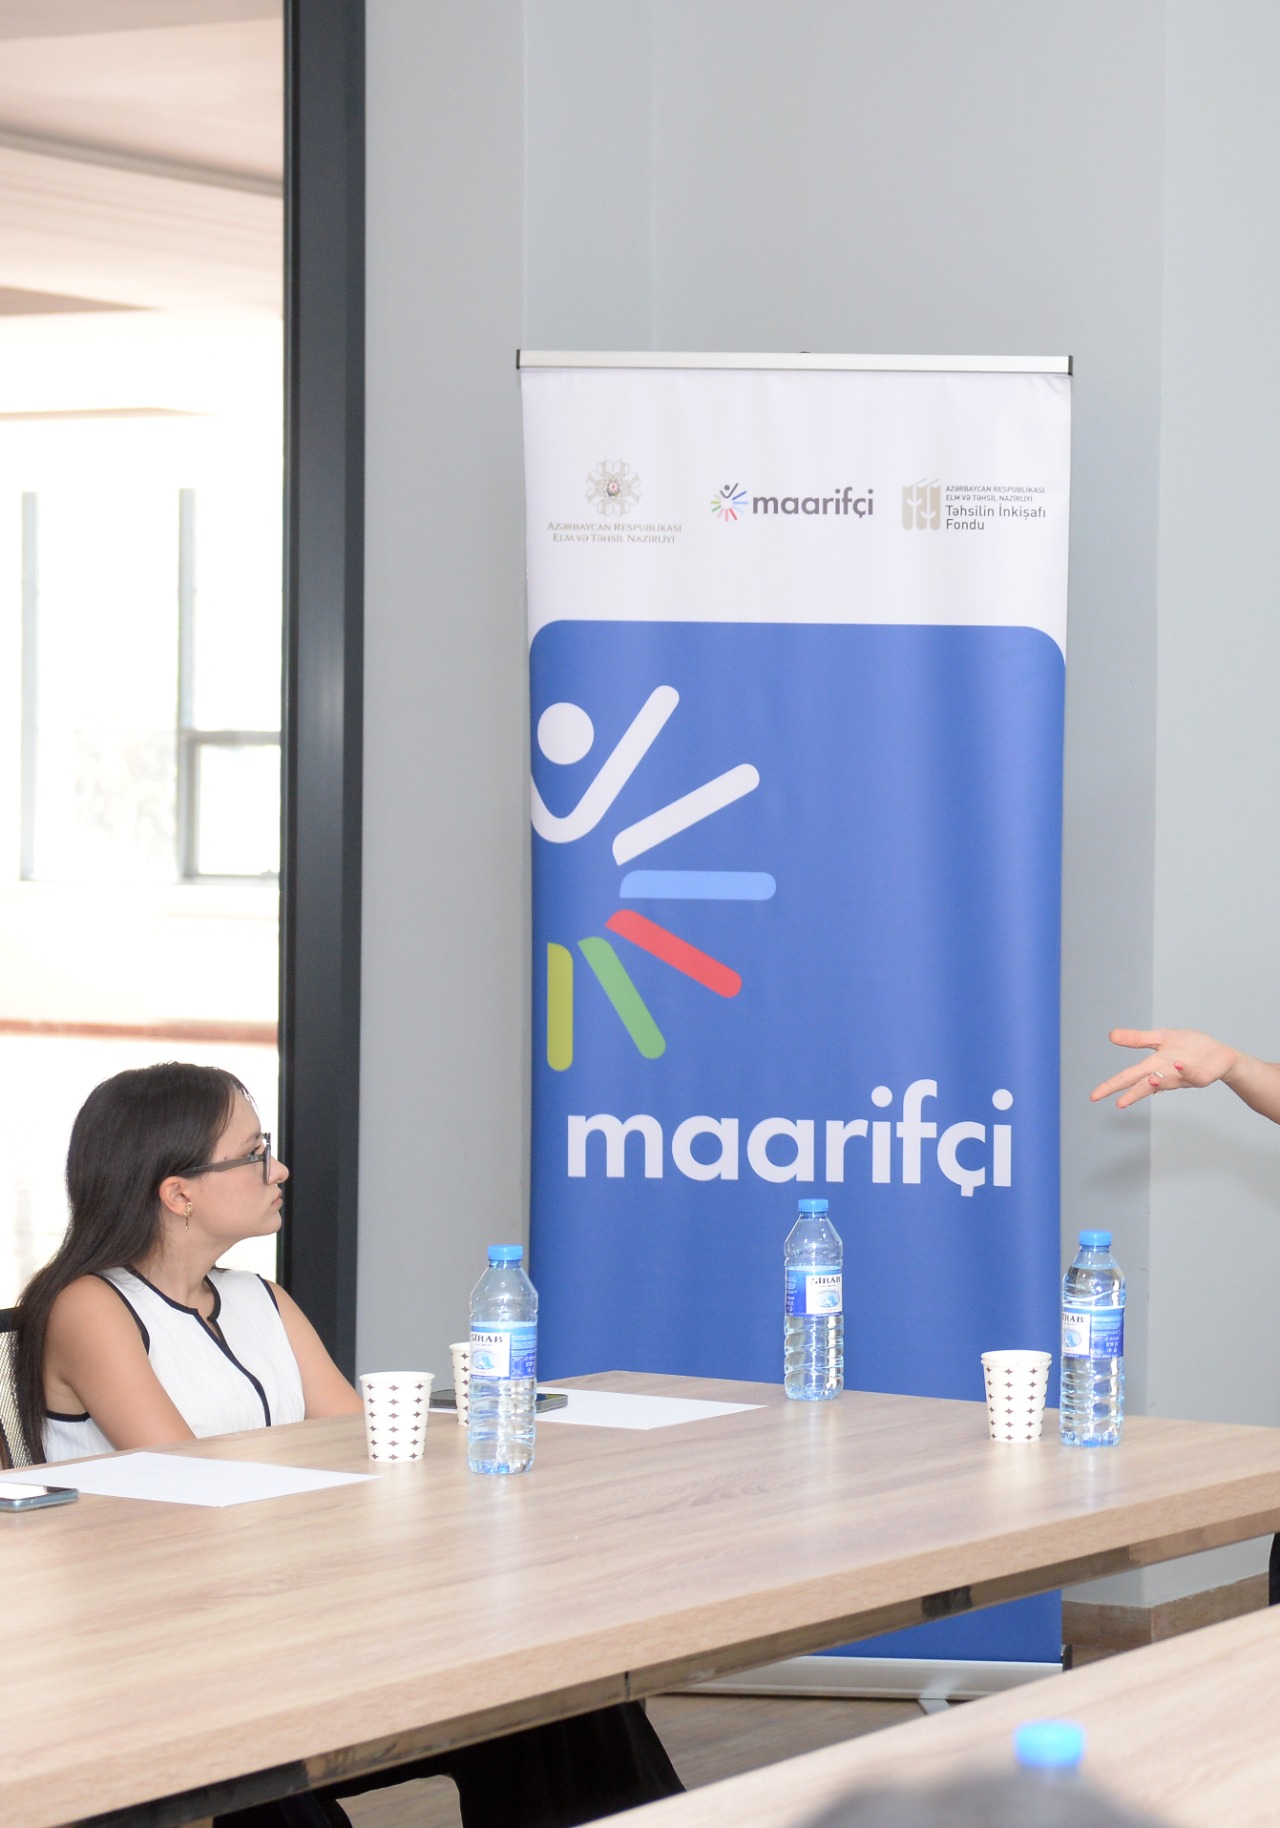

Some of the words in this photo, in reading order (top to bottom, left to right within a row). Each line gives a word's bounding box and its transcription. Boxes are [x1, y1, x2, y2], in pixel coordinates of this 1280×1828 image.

[753, 486, 874, 518] maarifçi
[946, 505, 995, 517] Təhsilin
[998, 503, 1046, 520] İnkişafı
[946, 518, 985, 530] Fondu
[567, 1078, 1014, 1197] maarifçi
